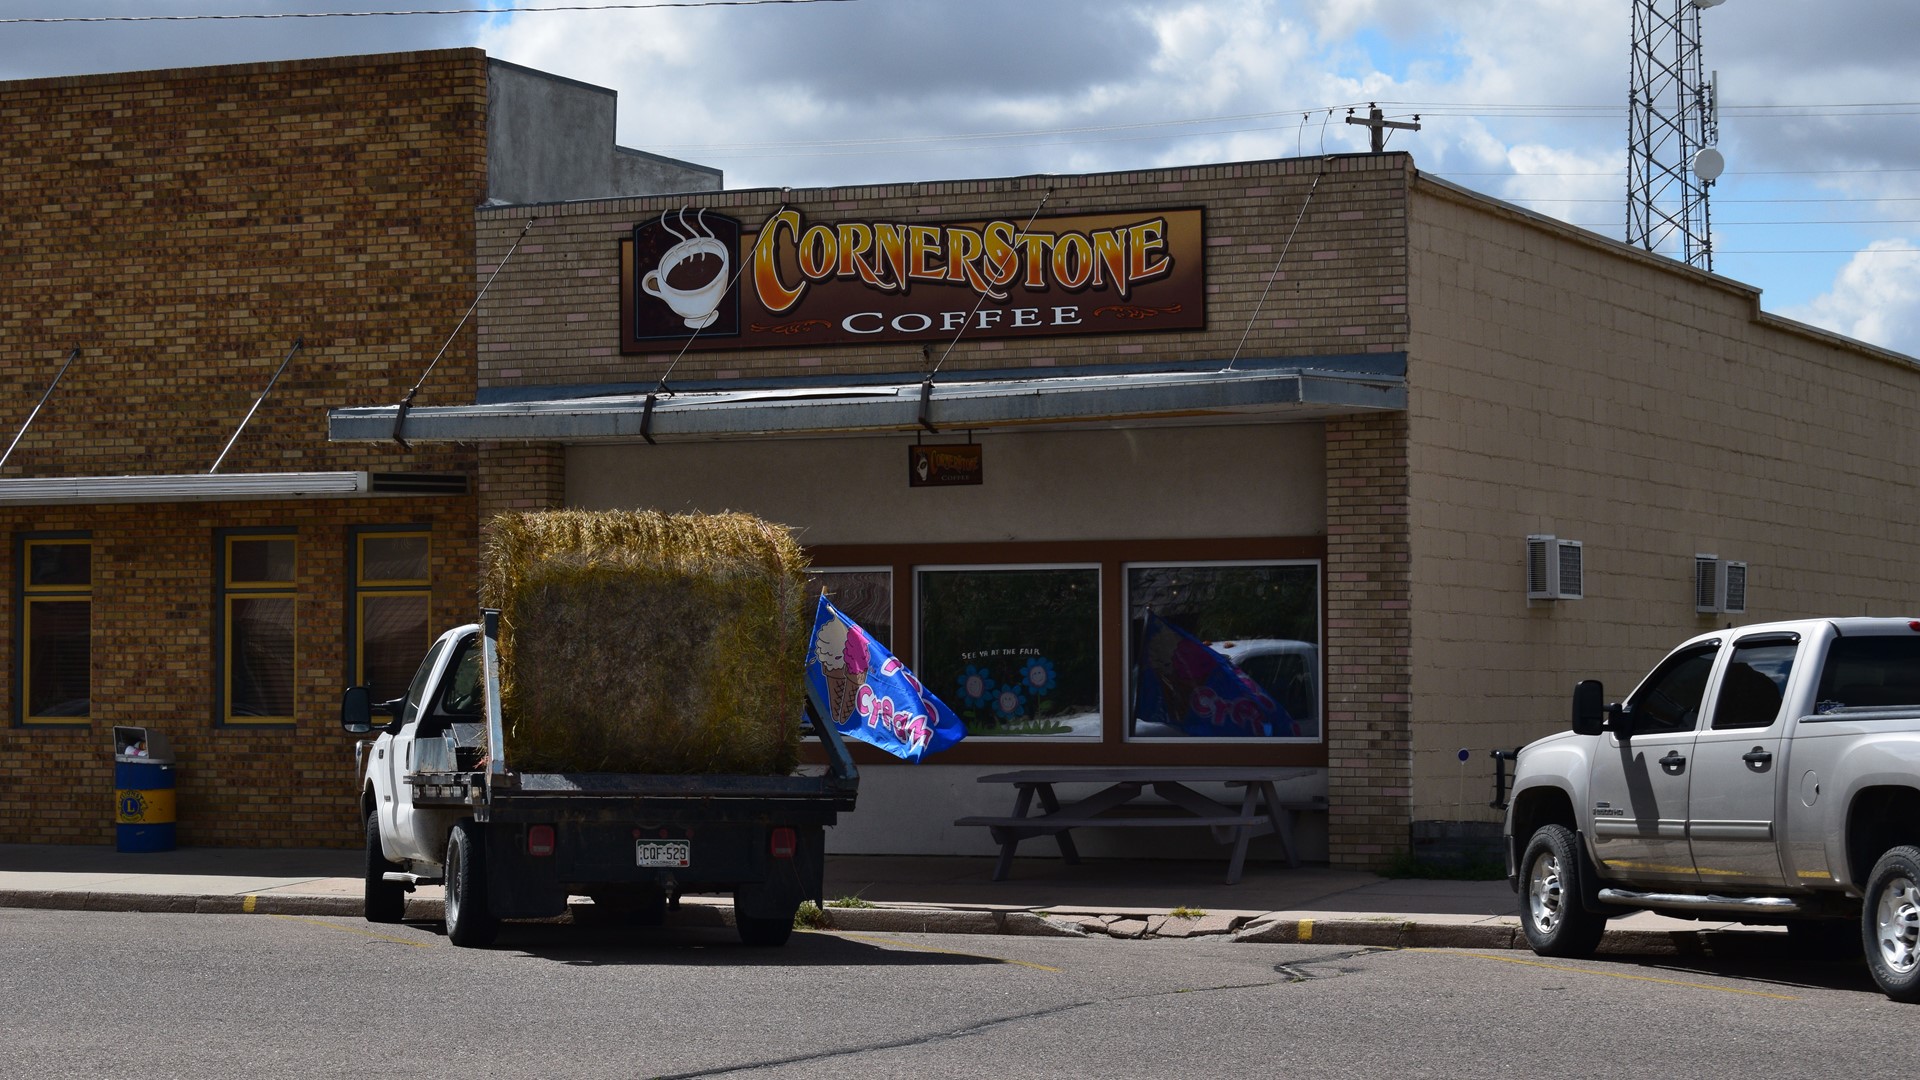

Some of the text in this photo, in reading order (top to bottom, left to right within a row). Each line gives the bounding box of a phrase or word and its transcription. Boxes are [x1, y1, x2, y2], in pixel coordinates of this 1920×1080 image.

[754, 210, 1170, 311] CORNERSTONE
[842, 306, 1083, 334] COFFEE
[961, 651, 977, 660] SEE
[855, 683, 934, 753] Cream
